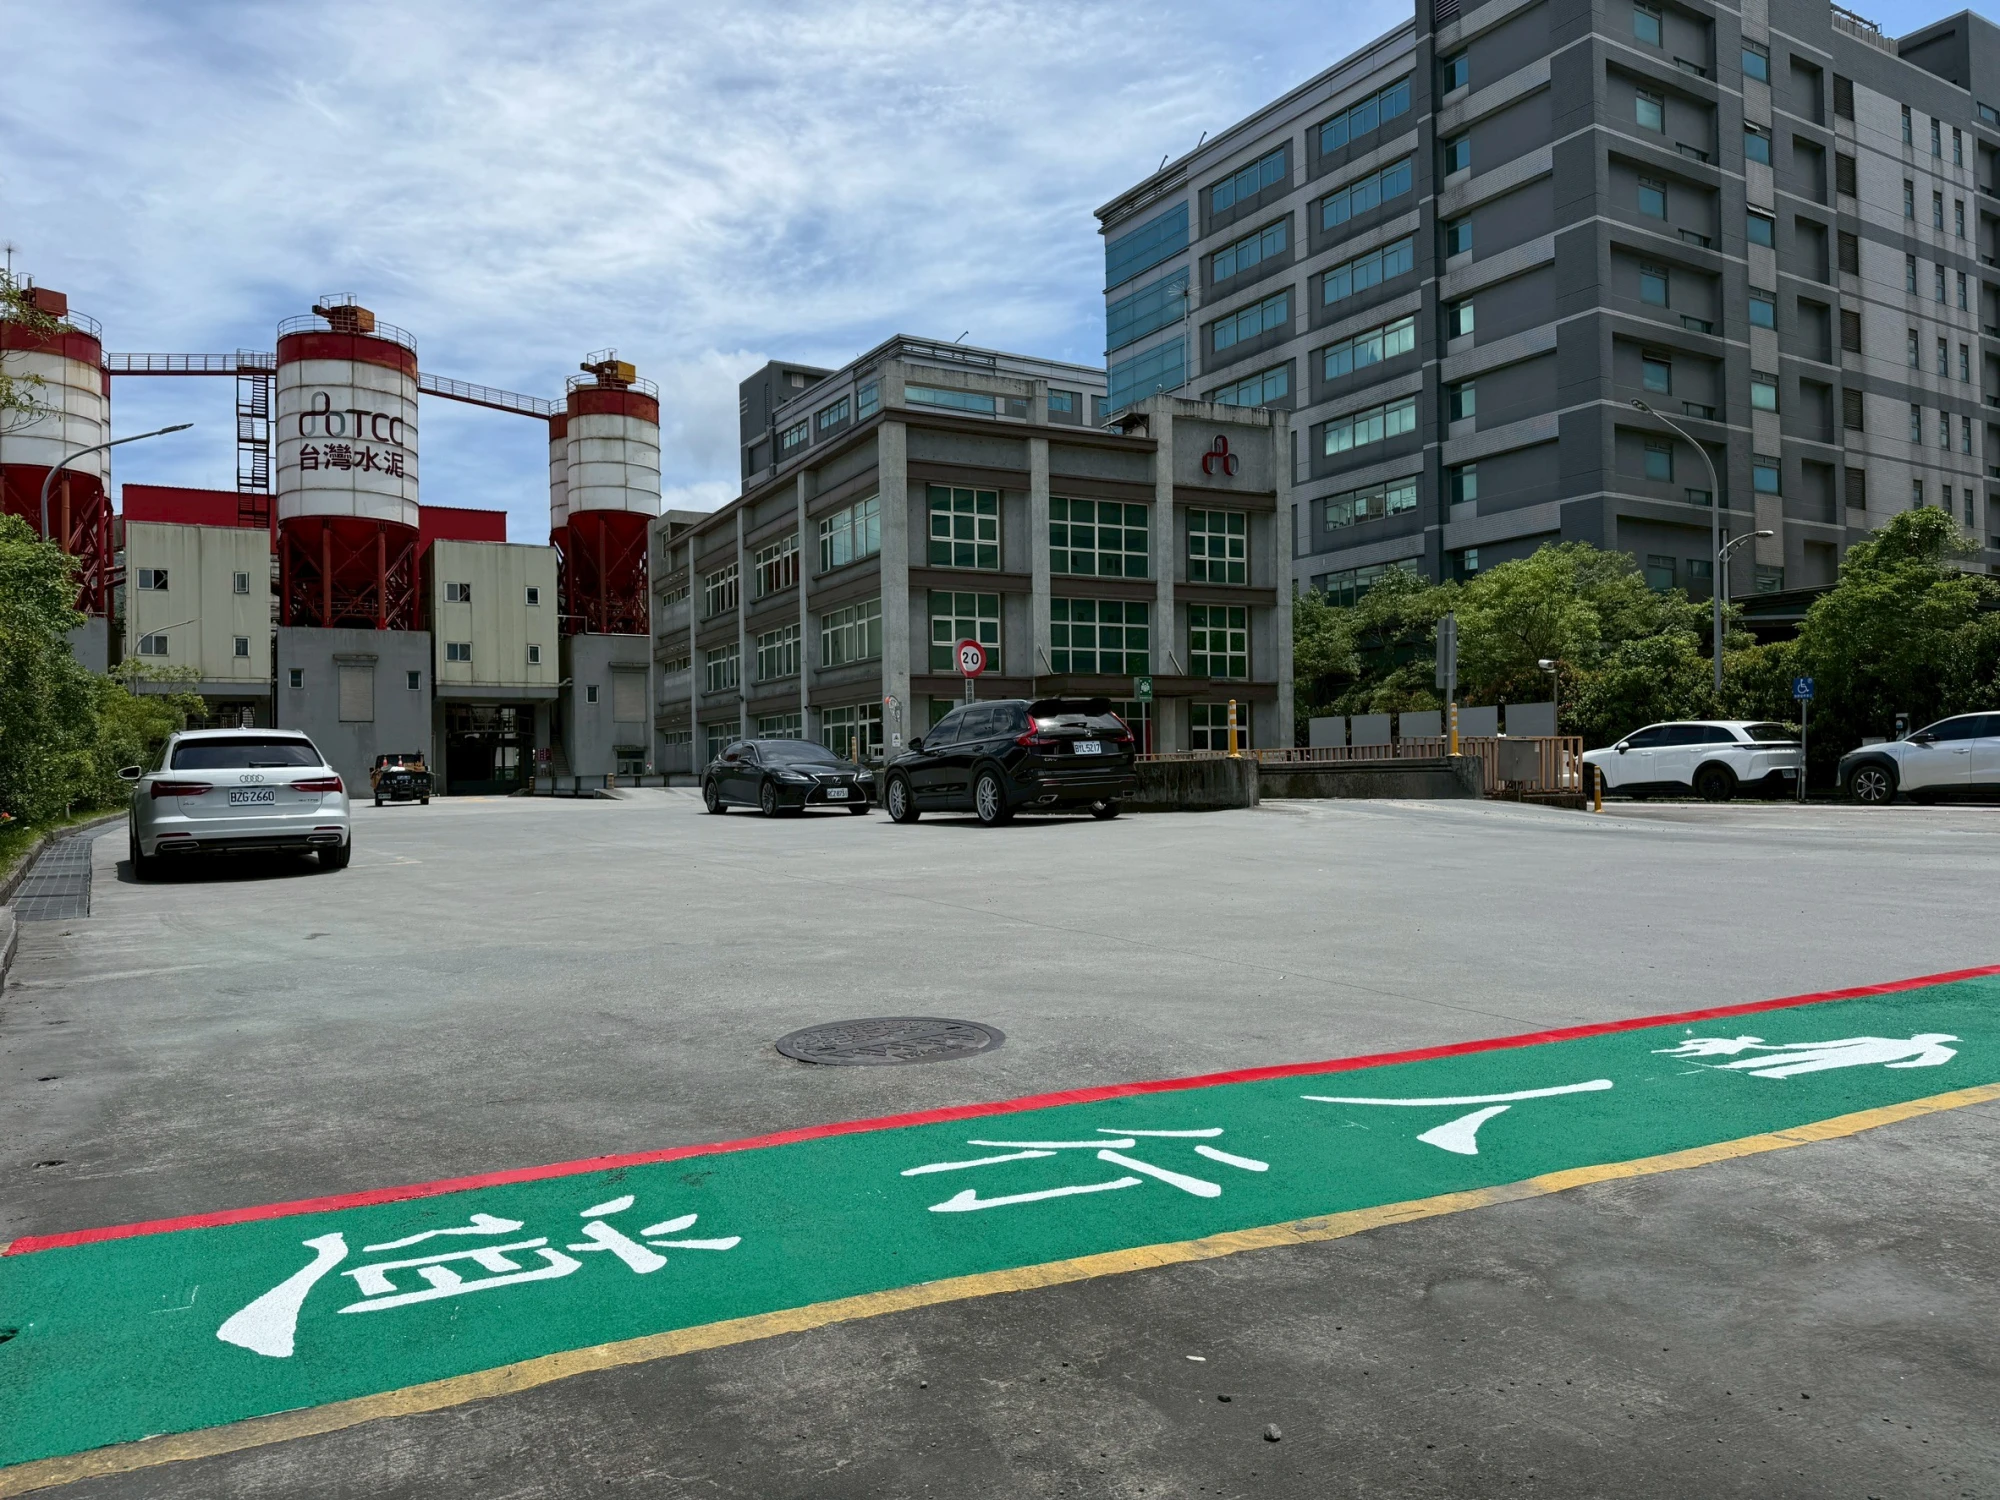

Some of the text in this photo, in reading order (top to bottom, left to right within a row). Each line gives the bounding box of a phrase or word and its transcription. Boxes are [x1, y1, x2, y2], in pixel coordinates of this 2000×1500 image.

[345, 409, 404, 446] TCC
[299, 443, 404, 478] 台灣水泥
[962, 652, 979, 665] 20
[230, 790, 275, 803] BZG-2660
